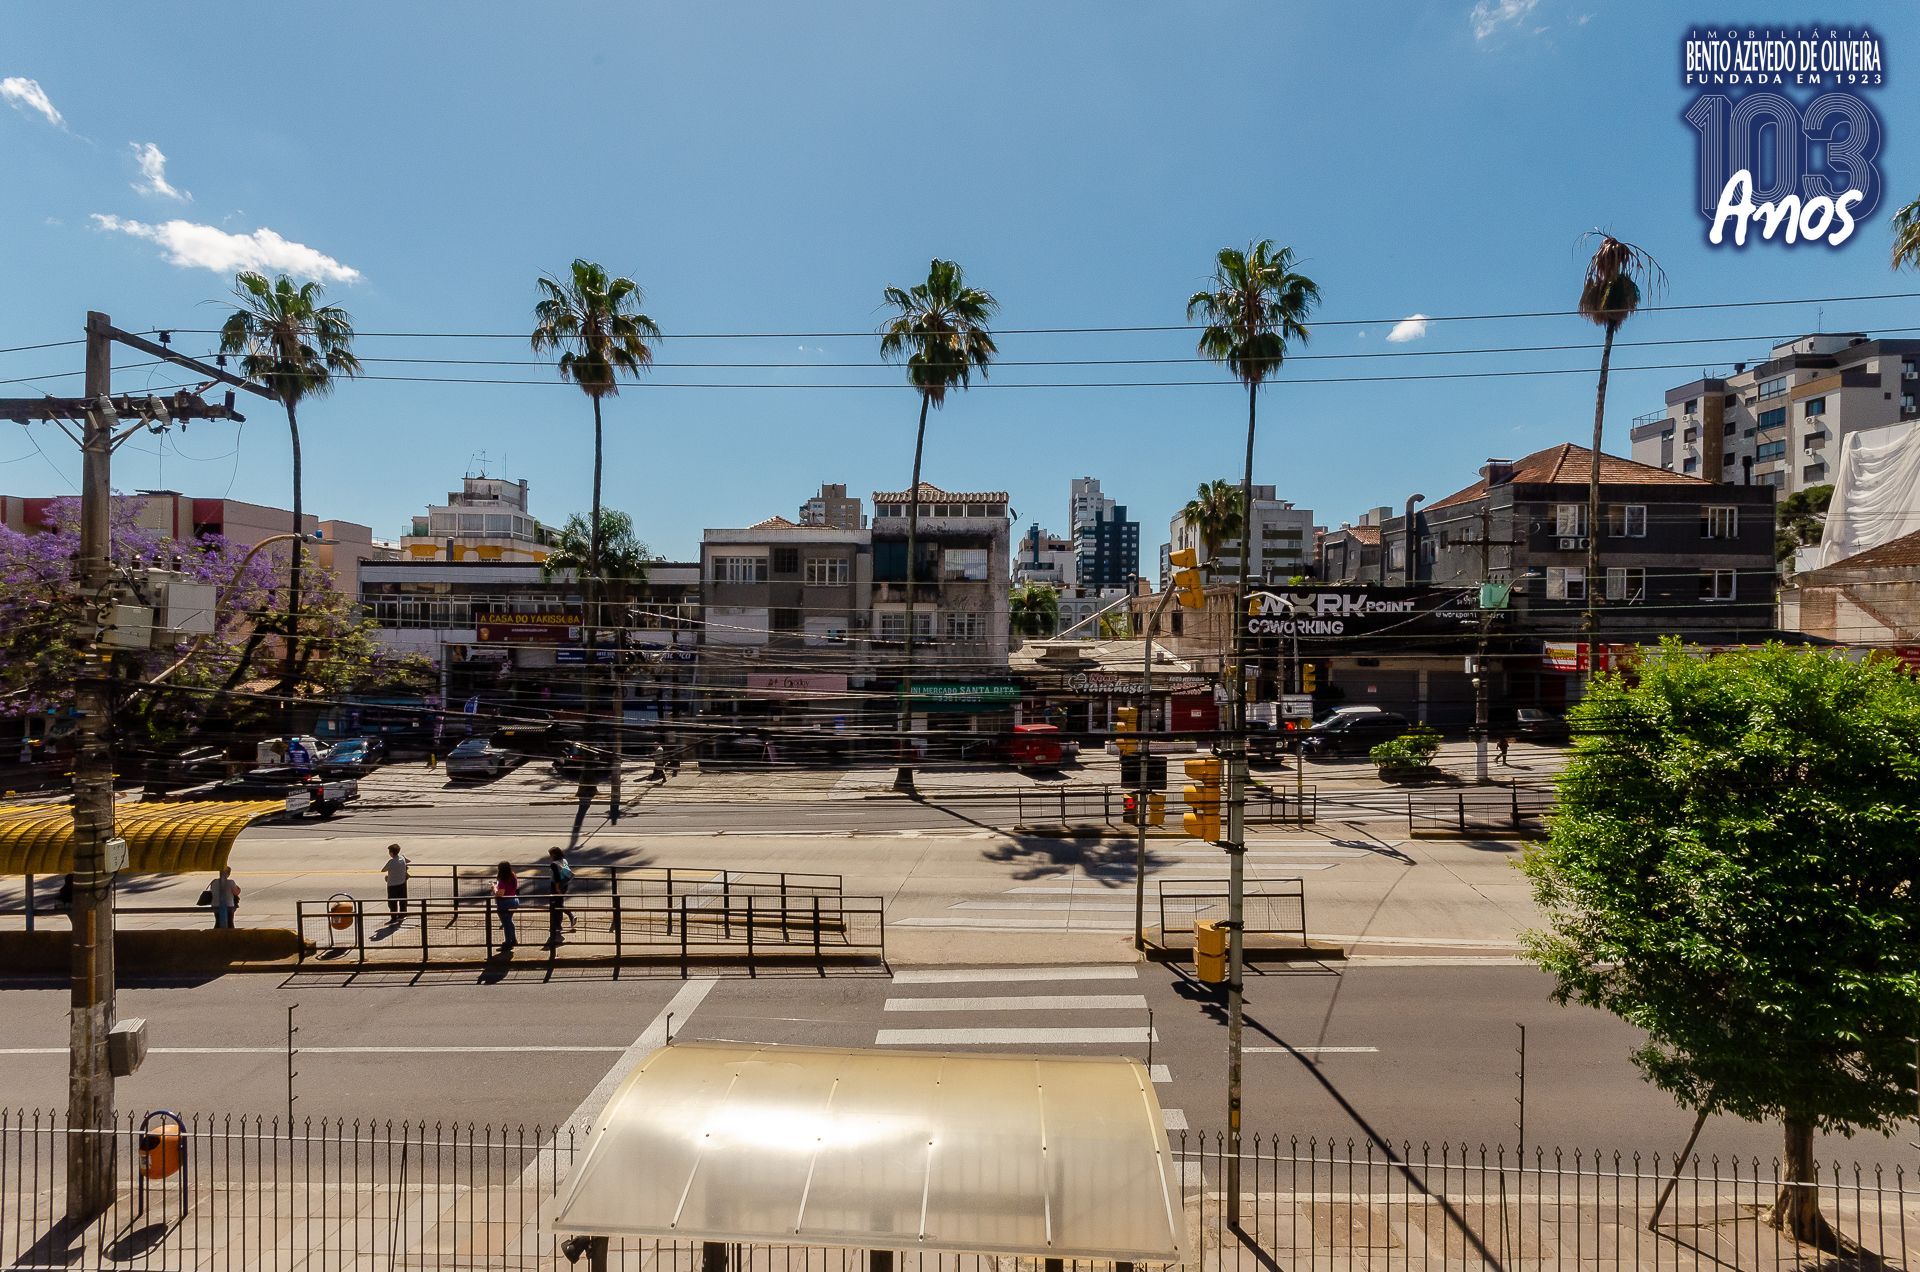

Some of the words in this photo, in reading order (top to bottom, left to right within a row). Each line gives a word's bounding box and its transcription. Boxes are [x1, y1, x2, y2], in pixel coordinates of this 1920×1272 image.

[480, 615, 487, 624] A
[489, 615, 514, 624] CASA
[515, 615, 528, 624] DO
[1248, 619, 1344, 634] COWORKING
[922, 687, 958, 695] MERCADO
[959, 686, 990, 695] SANTA
